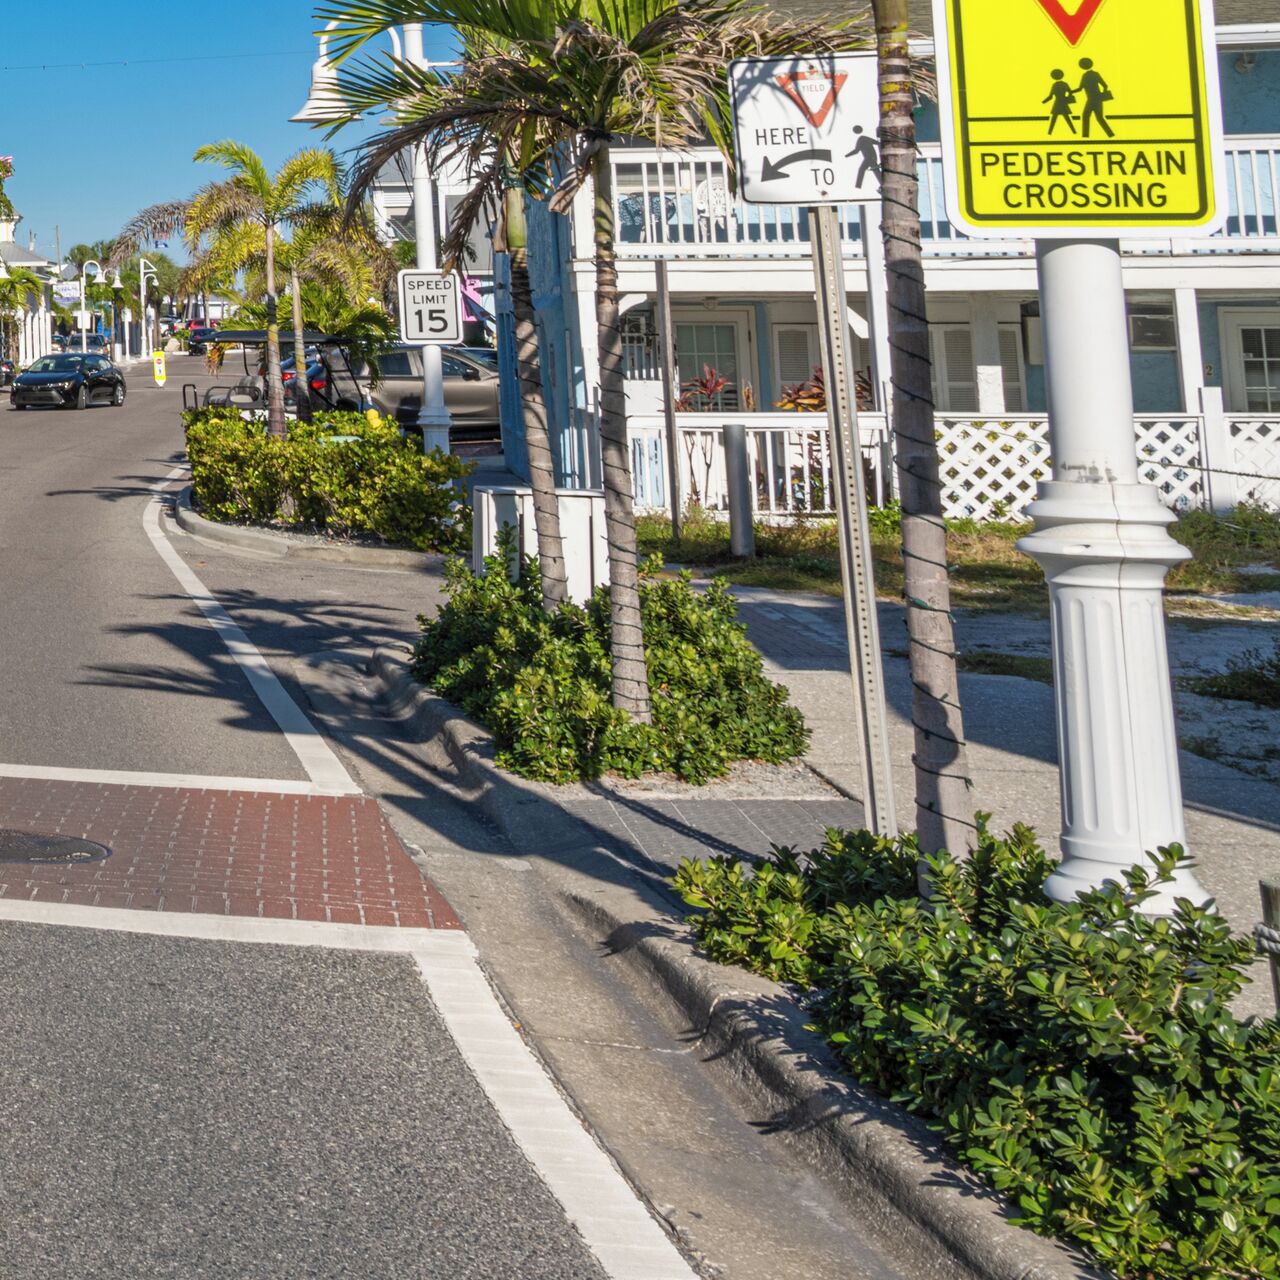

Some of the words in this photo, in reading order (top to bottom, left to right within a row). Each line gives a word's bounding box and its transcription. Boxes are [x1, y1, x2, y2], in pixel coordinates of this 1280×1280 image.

[801, 83, 825, 93] YIELD
[755, 127, 808, 146] HERE
[980, 150, 1187, 177] PEDESTRAIN
[811, 167, 835, 186] TO
[1003, 182, 1168, 208] CROSSING
[408, 280, 452, 291] SPEED
[413, 295, 447, 305] LIMIT
[415, 309, 448, 333] 15
